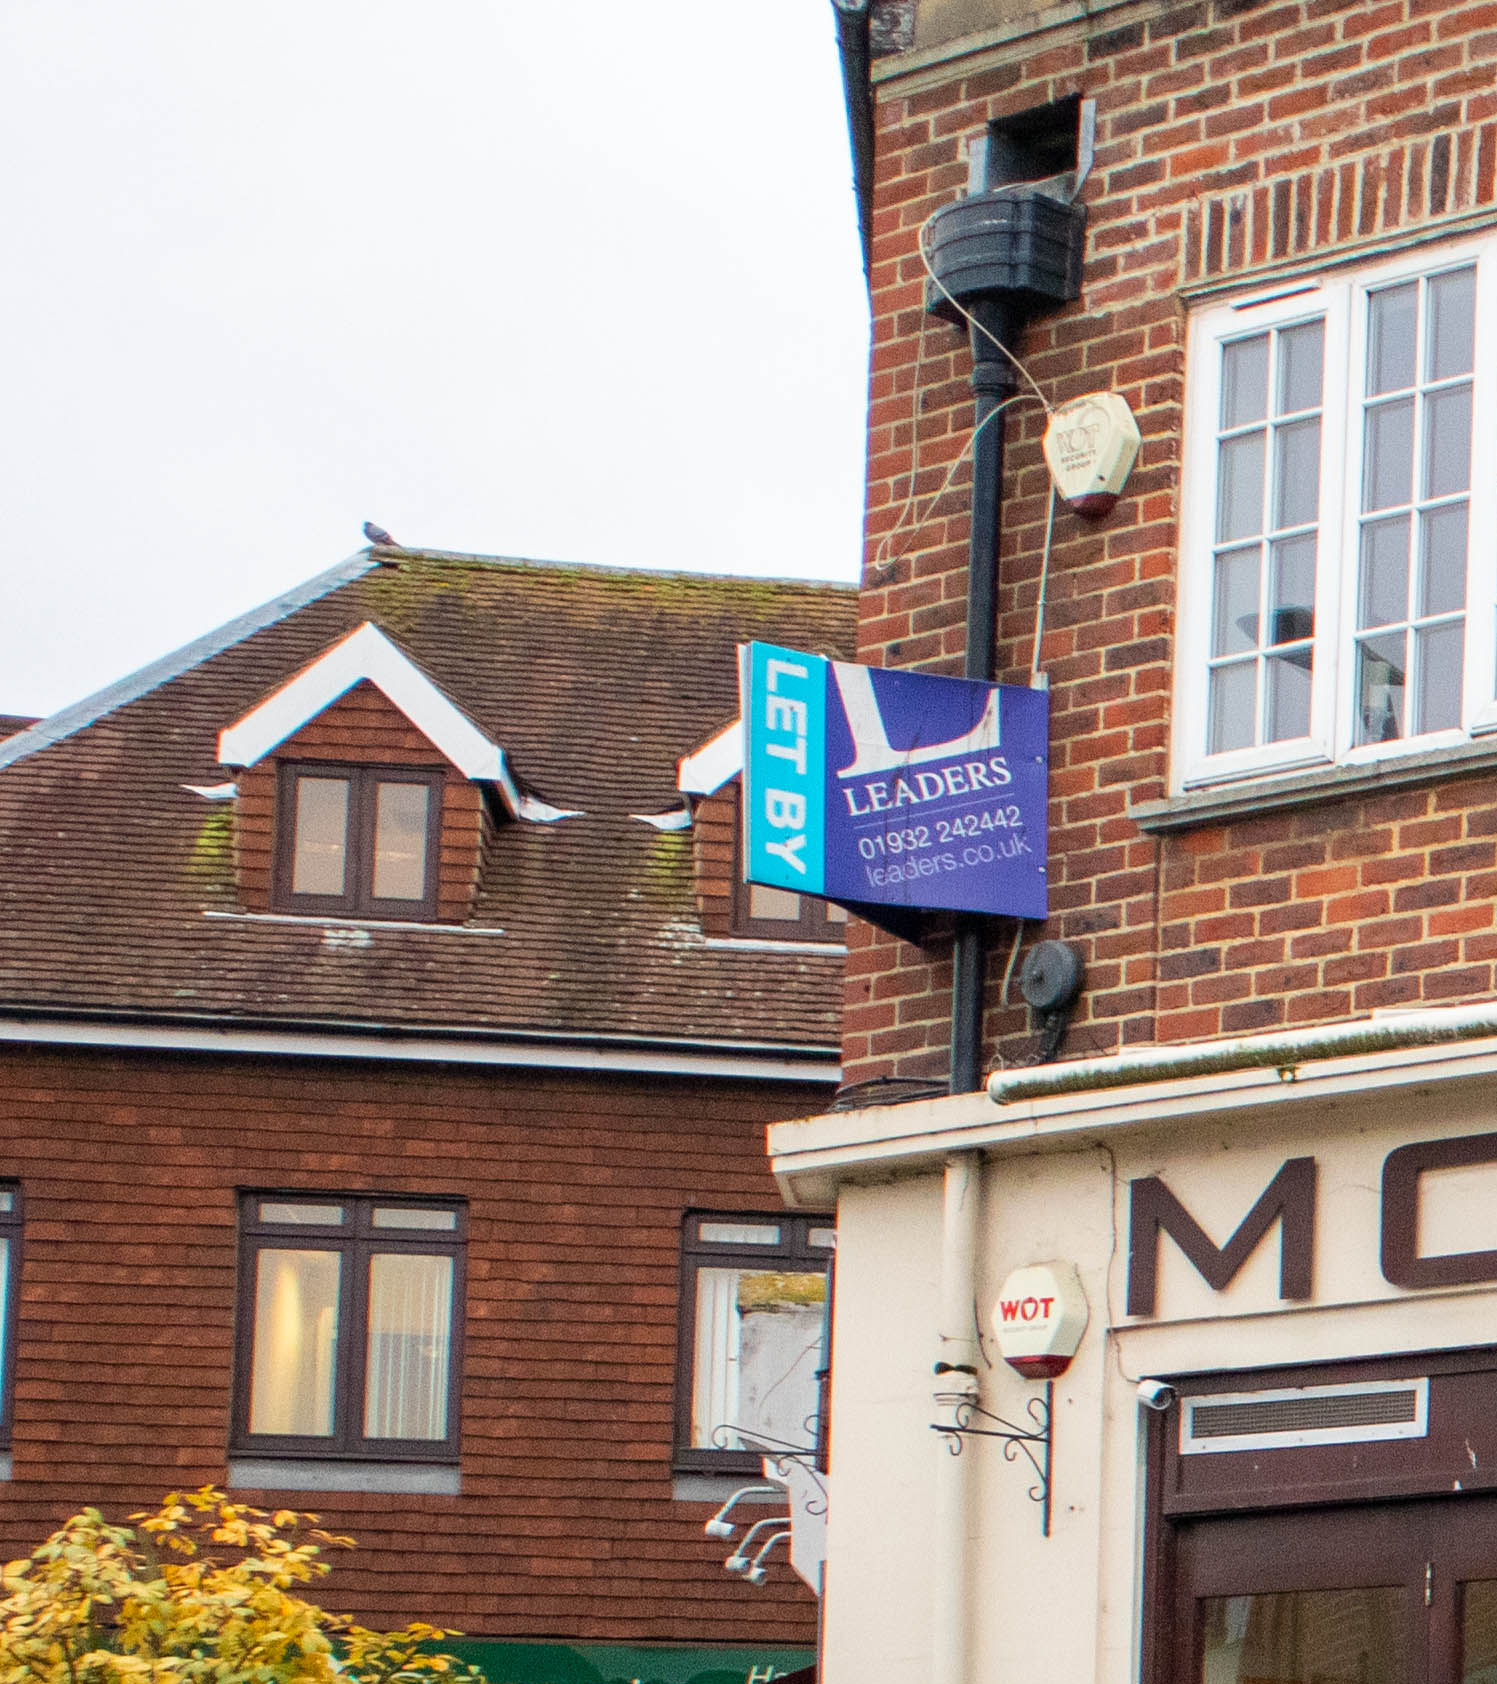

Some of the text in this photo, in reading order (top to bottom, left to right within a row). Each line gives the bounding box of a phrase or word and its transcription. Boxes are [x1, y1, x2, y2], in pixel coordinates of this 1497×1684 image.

[766, 658, 808, 775] LET
[842, 756, 1013, 817] LEADERS
[765, 787, 807, 875] BY
[858, 805, 1024, 860] 01932 242442
[865, 832, 1033, 888] leaders.co.uk
[1000, 1296, 1055, 1322] WOT
